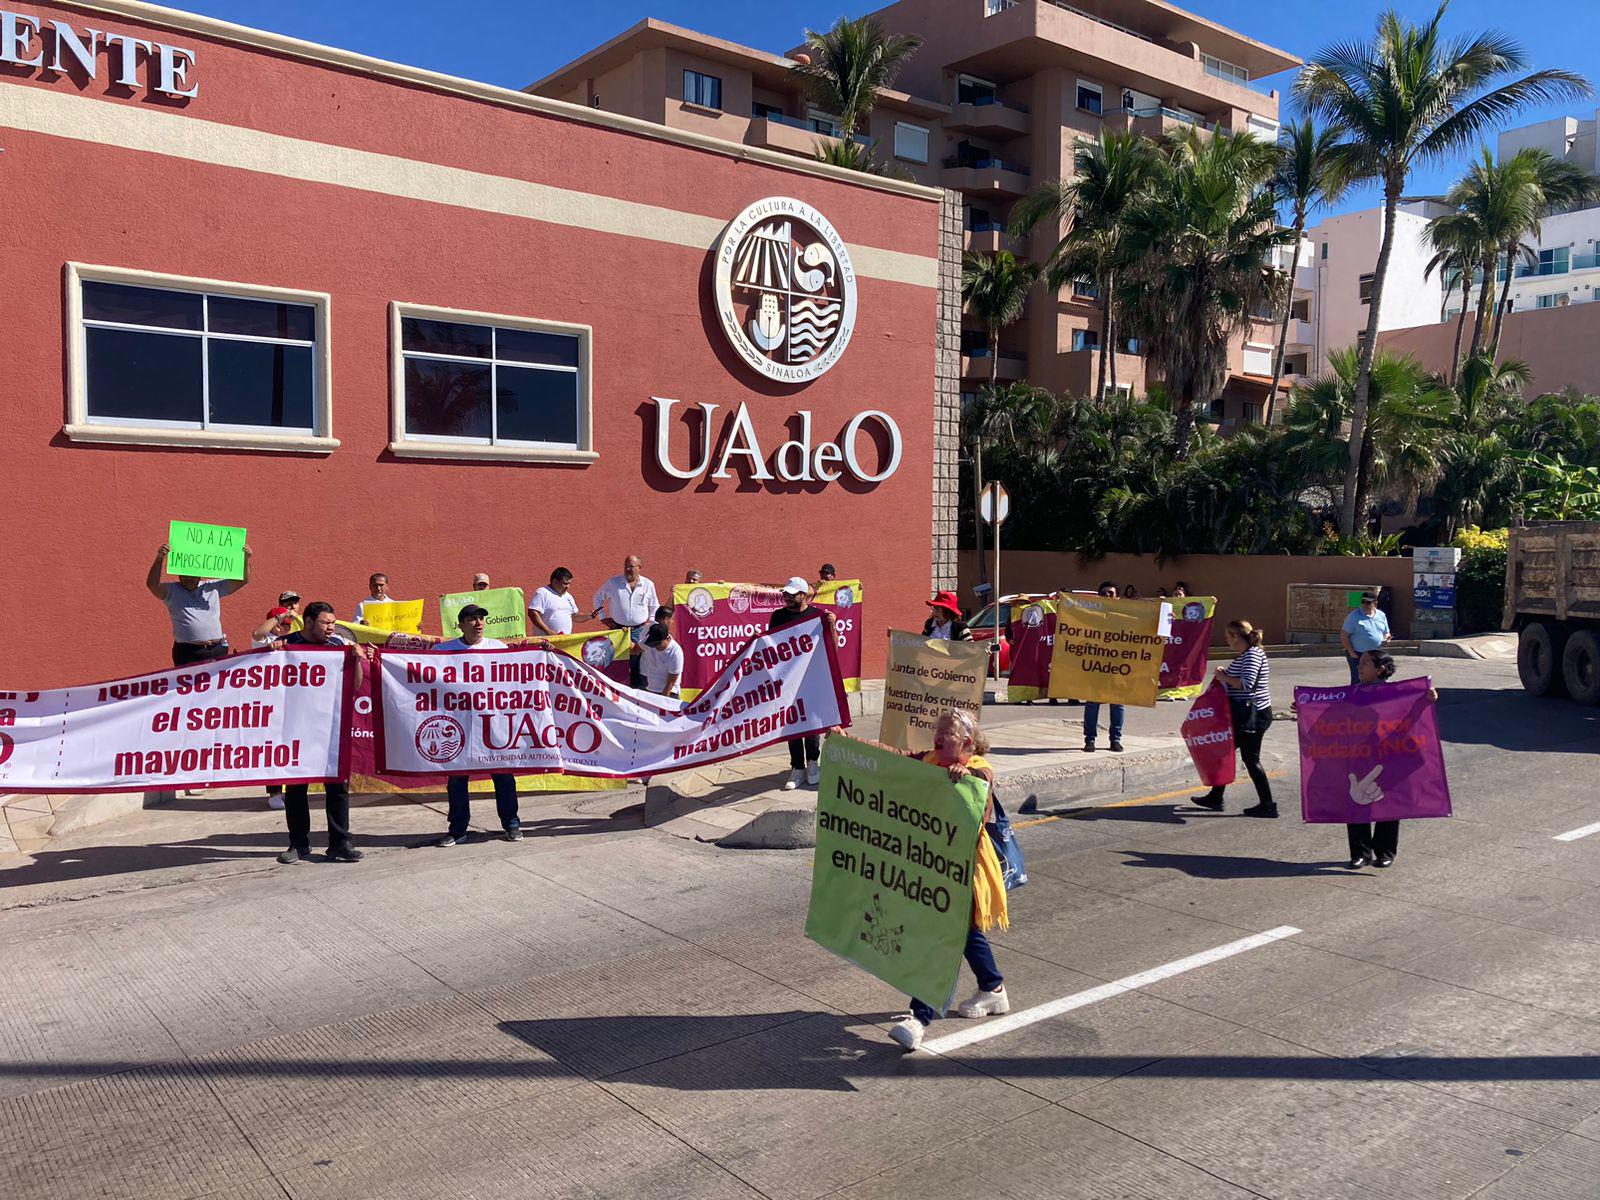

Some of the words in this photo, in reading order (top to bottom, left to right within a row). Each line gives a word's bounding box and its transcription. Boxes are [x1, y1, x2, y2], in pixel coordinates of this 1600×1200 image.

[722, 237, 736, 265] POR
[735, 219, 748, 234] LA
[748, 200, 794, 219] CULTURA
[799, 206, 806, 214] A
[809, 212, 822, 225] LA
[824, 225, 853, 284] LIBERTAD
[766, 363, 812, 379] SINALOA
[651, 396, 902, 482] UAdeO
[186, 527, 203, 544] NO
[207, 530, 214, 544] A
[219, 530, 233, 547] LA
[170, 551, 234, 572] IMPOSICION
[485, 614, 520, 625] Gobierno
[1058, 622, 1082, 638] Por
[1084, 628, 1101, 639] un
[1104, 630, 1163, 647] gobierno
[696, 641, 727, 657] CON
[734, 631, 815, 683] respete
[1065, 640, 1119, 658] legítimo
[1121, 649, 1138, 660] en
[1140, 648, 1152, 661] la
[176, 671, 211, 696] se
[217, 662, 326, 690] respete
[408, 661, 436, 684] No
[443, 665, 457, 683] a
[463, 661, 484, 683] la
[917, 667, 929, 678] de
[930, 668, 976, 684] Gobierno
[1081, 660, 1131, 676] UAdeO
[415, 688, 438, 712] al
[554, 692, 582, 717] en
[721, 678, 784, 720] sentir
[886, 701, 903, 712] para
[904, 702, 928, 716] darle
[930, 707, 939, 718] el
[924, 692, 939, 704] los
[940, 696, 980, 711] criterios
[151, 706, 181, 732] el
[186, 701, 274, 731] sentir
[909, 716, 937, 731] Flore
[673, 698, 808, 760] mayoritario!
[114, 740, 301, 776] mayoritario!
[529, 751, 561, 761] AUTÓNO
[837, 775, 864, 806] No
[868, 791, 884, 815] al
[888, 799, 942, 836] acoso
[945, 821, 957, 847] y
[818, 810, 902, 856] amenaza
[906, 835, 969, 886] laboral
[832, 848, 856, 873] en
[860, 852, 875, 881] la
[880, 861, 950, 913] UAdeO
